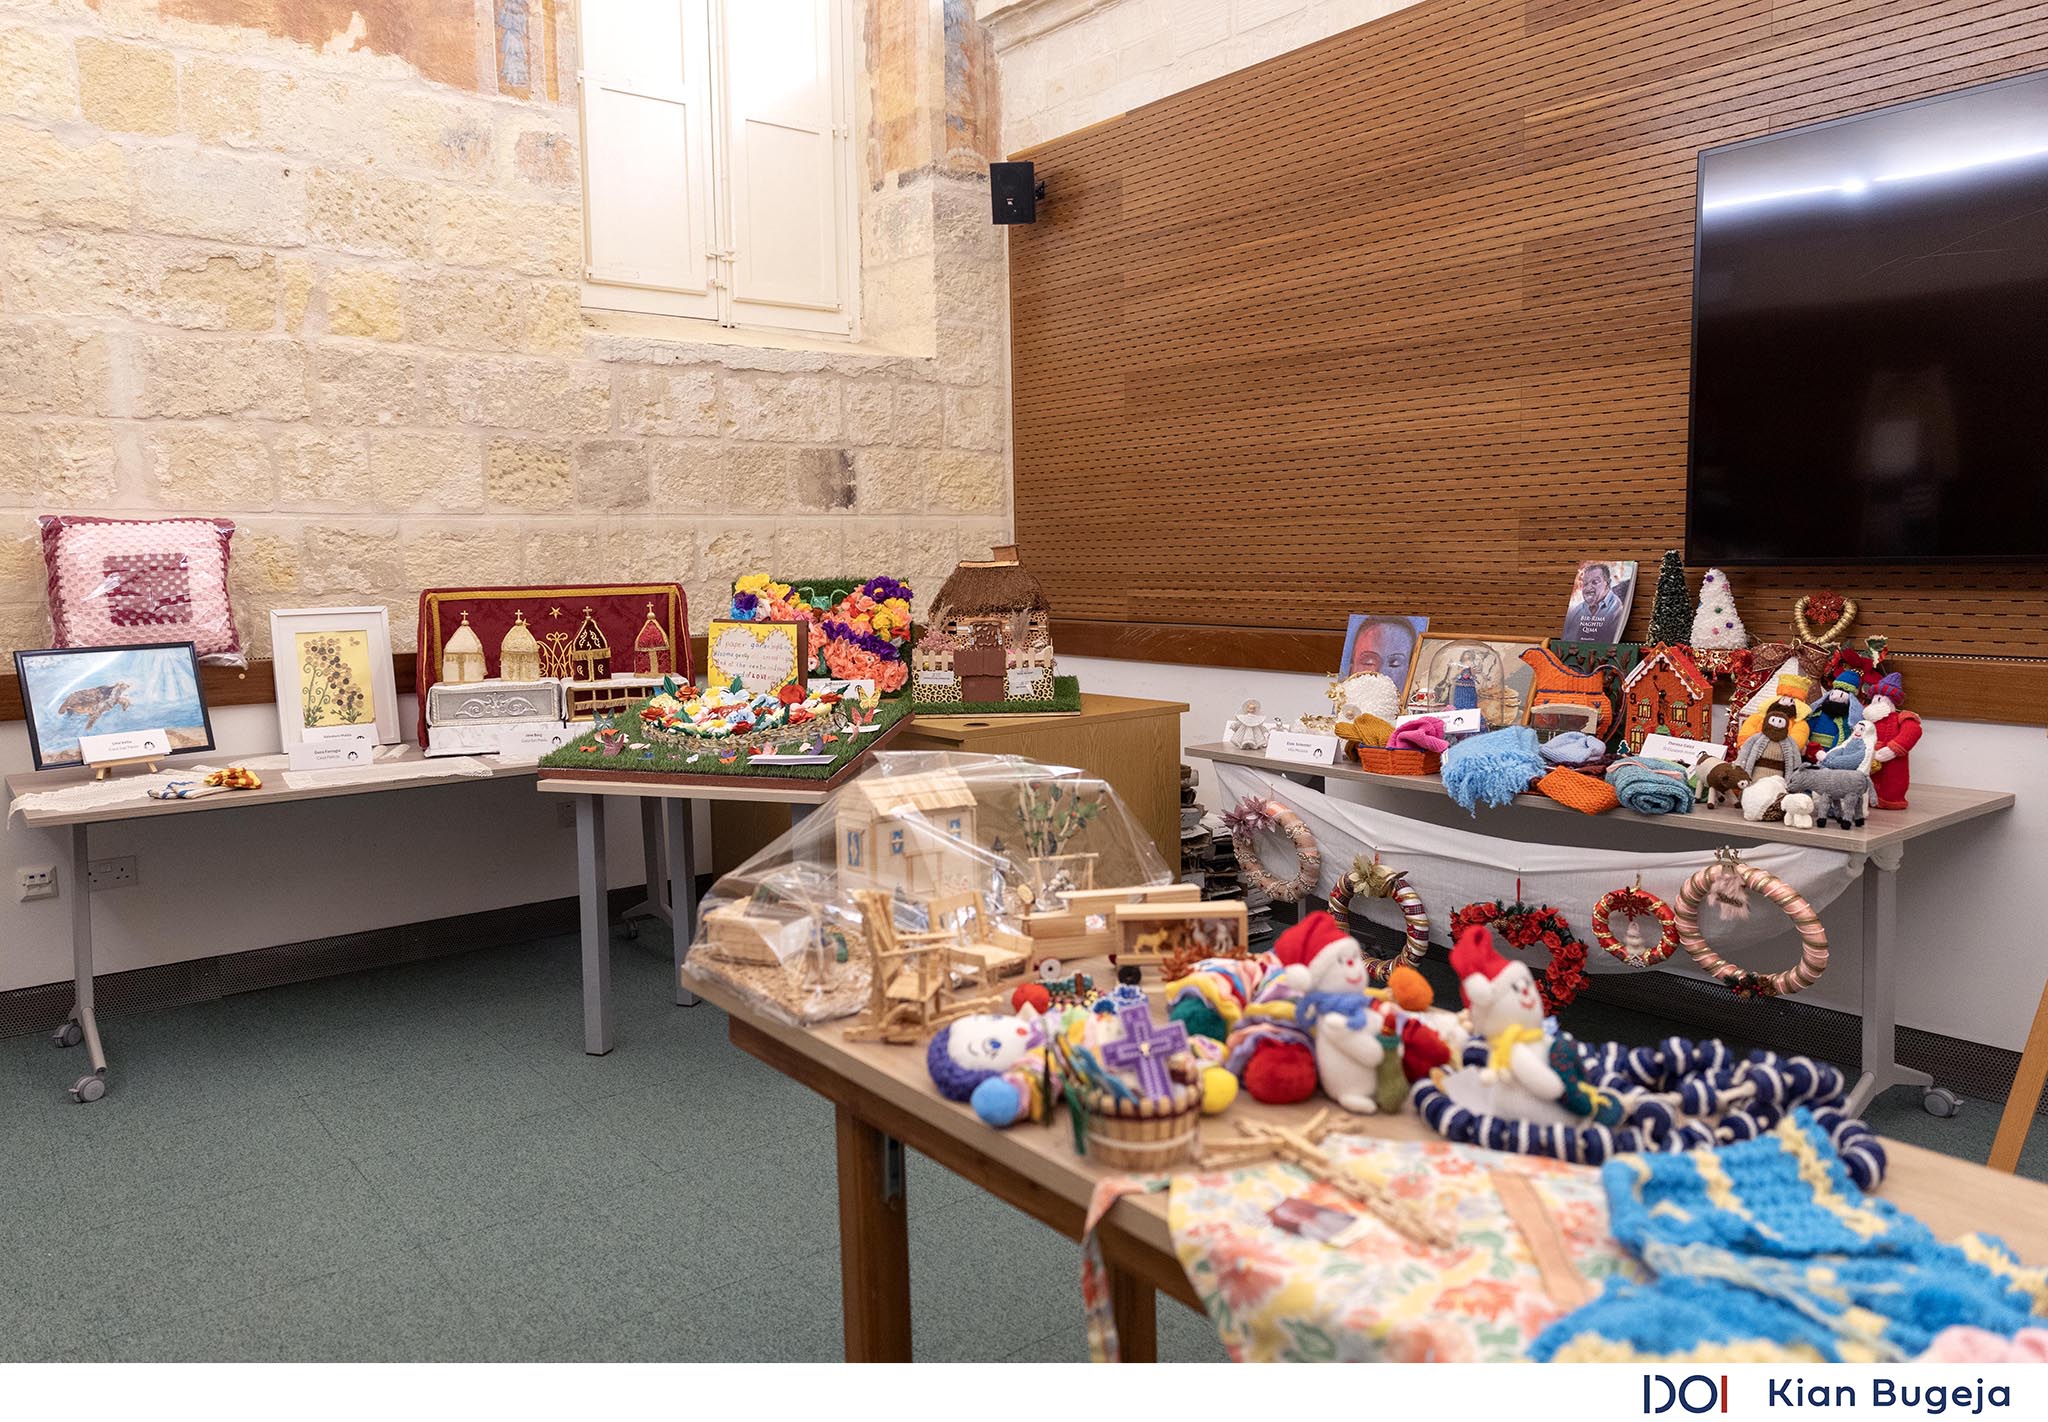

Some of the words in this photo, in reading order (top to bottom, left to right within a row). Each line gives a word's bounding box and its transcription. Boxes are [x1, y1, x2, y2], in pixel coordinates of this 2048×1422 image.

[1659, 657, 1669, 672] 12
[1629, 692, 1637, 705] 9
[1686, 691, 1695, 707] 3
[1657, 712, 1665, 726] 6
